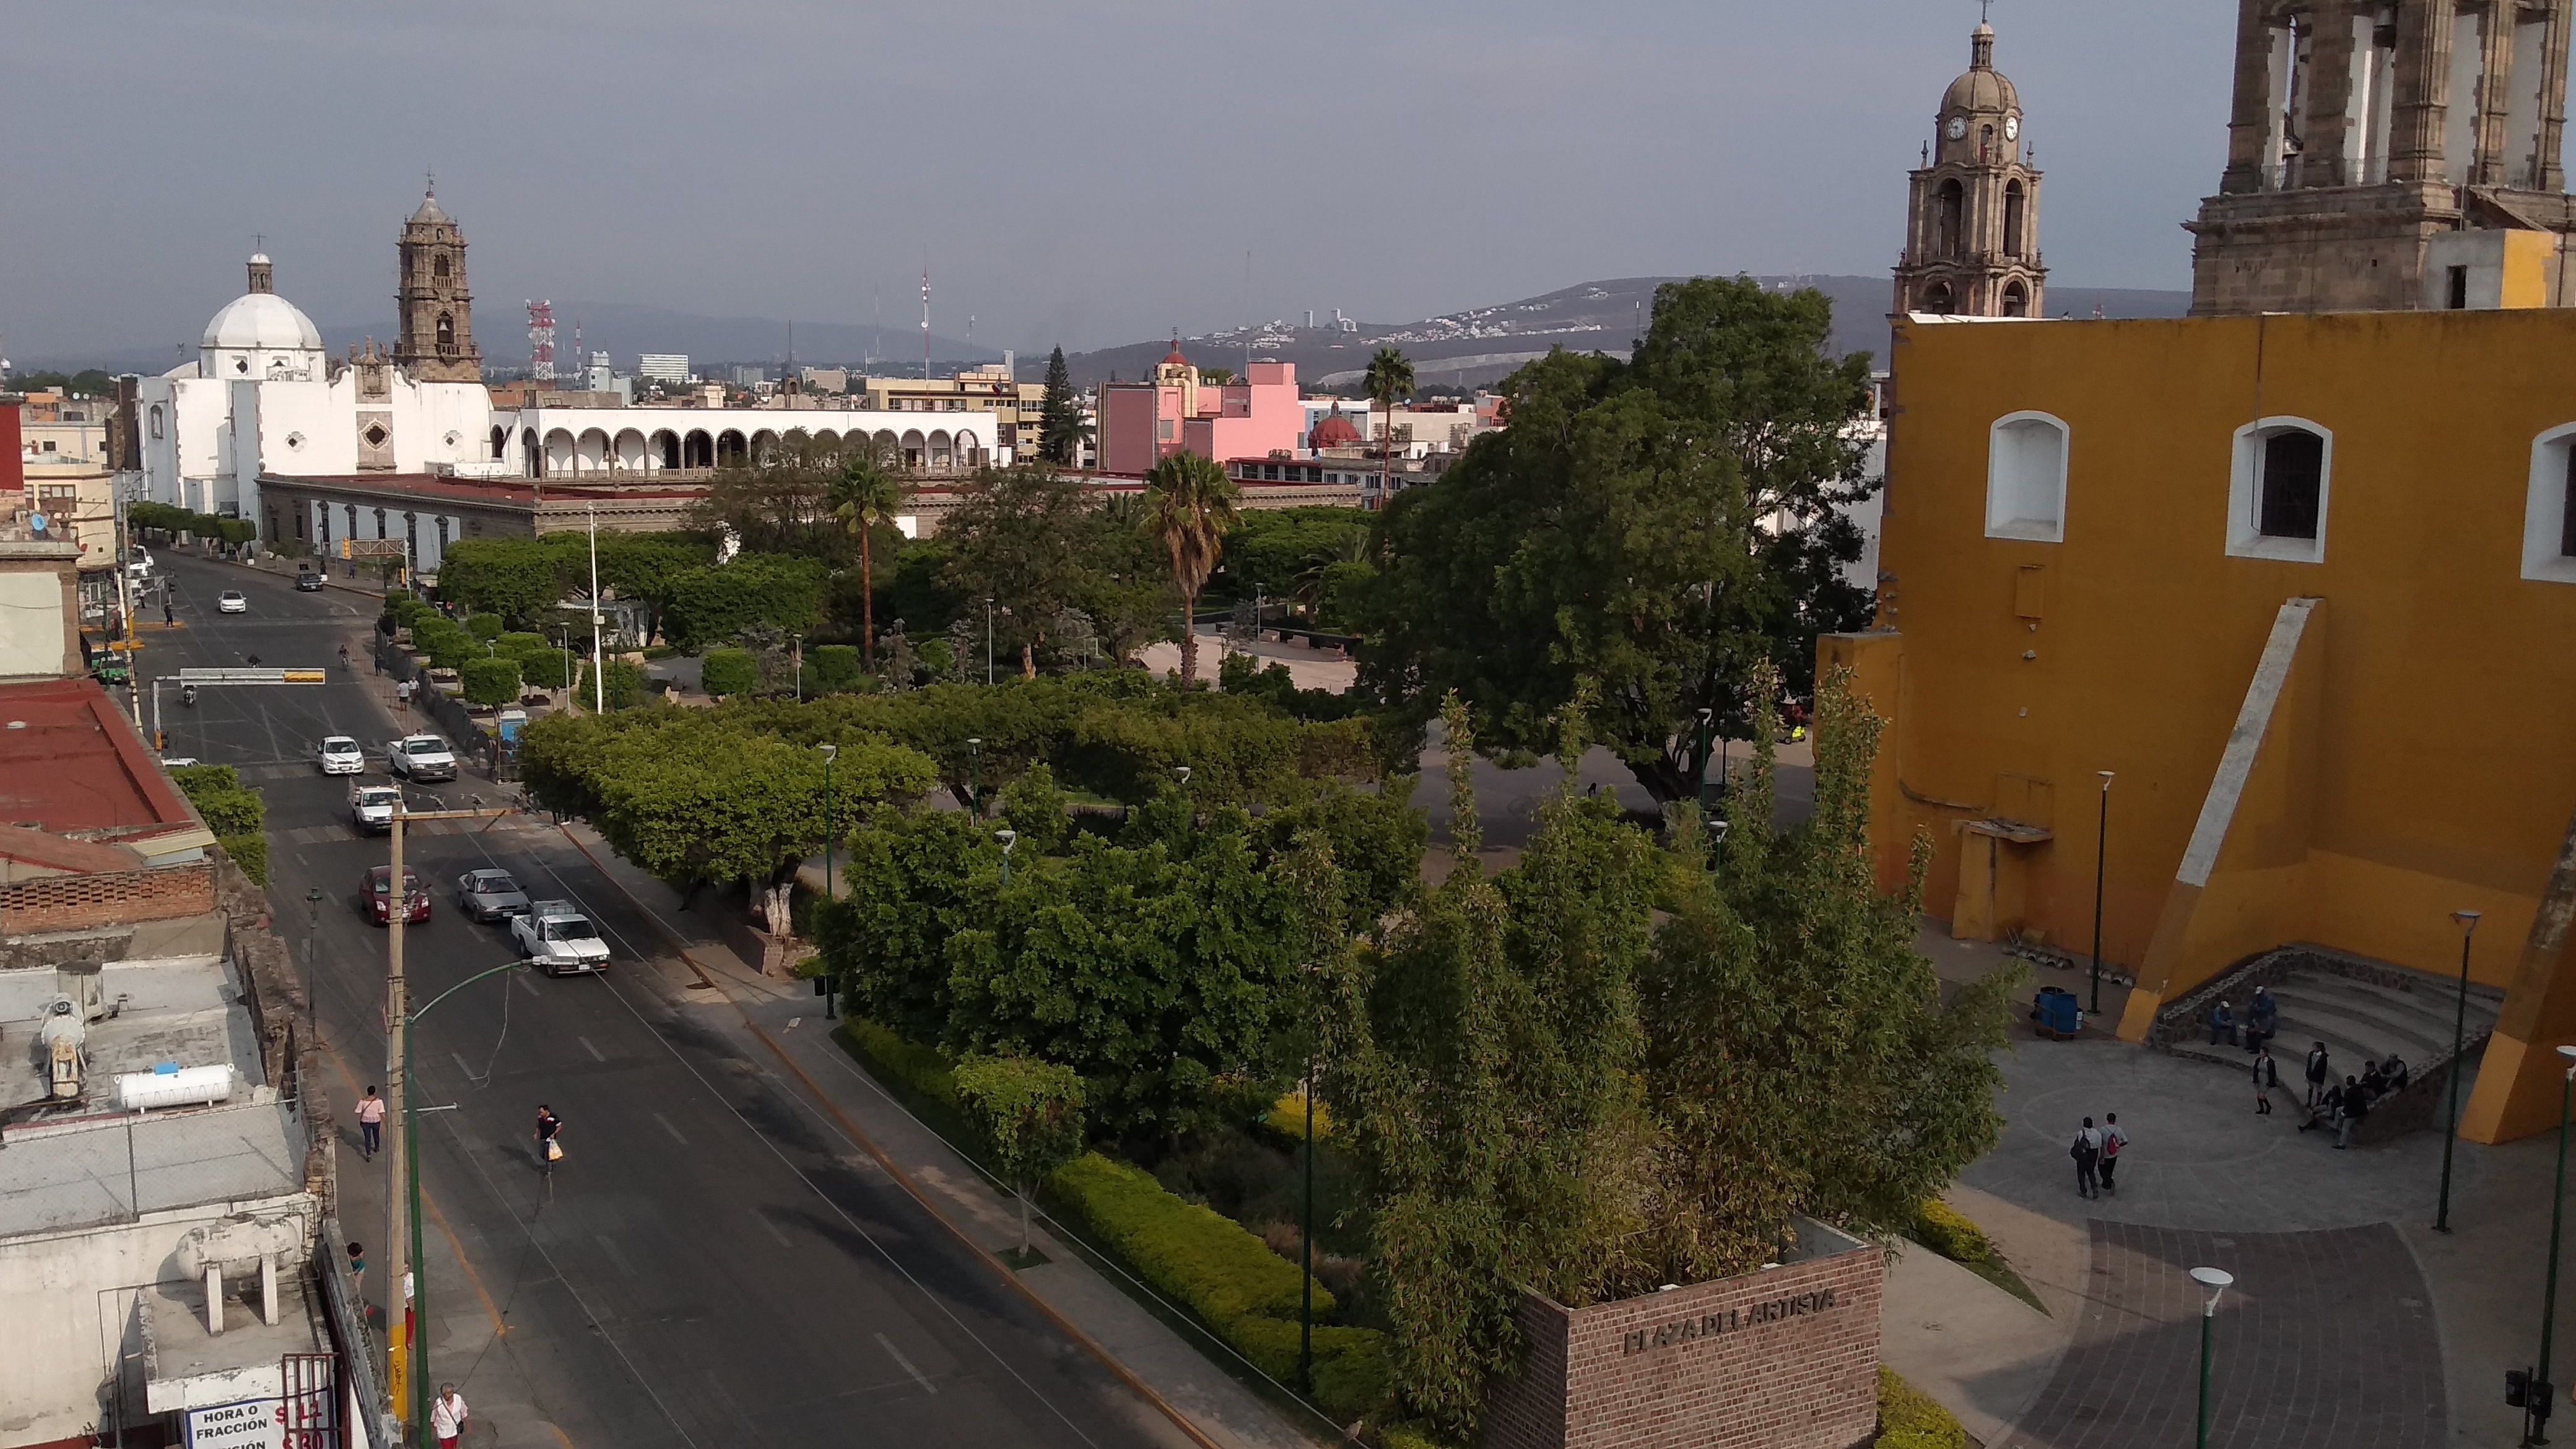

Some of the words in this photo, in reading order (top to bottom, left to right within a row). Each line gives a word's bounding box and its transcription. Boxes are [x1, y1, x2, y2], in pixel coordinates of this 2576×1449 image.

[1623, 1318, 1697, 1355] PLAZA
[1702, 1308, 1745, 1337] DEL
[1746, 1288, 1837, 1326] ARTISTA
[204, 1408, 245, 1424] HORA
[248, 1405, 258, 1415] O
[196, 1417, 268, 1440] FRACCIÓN
